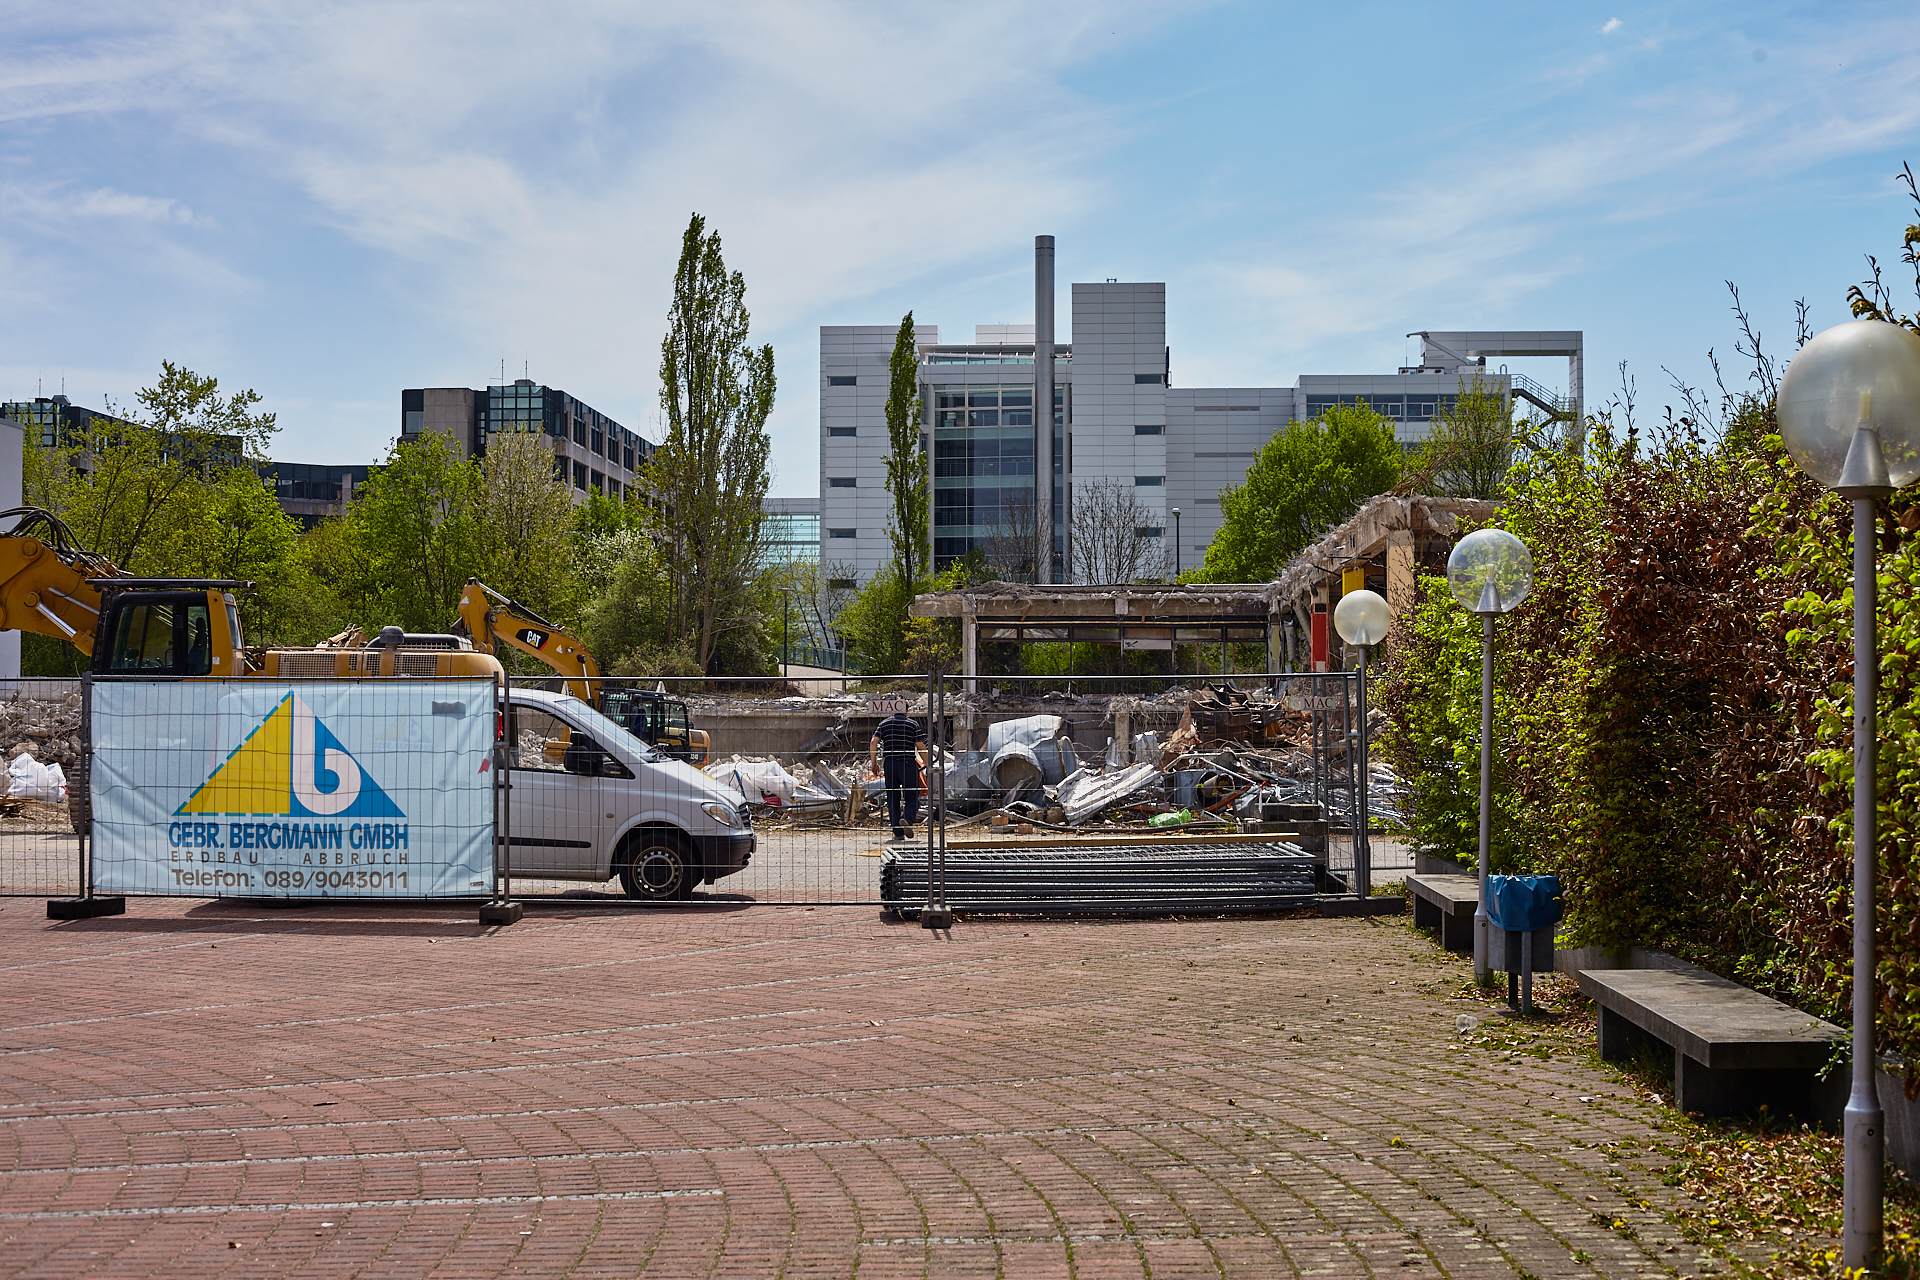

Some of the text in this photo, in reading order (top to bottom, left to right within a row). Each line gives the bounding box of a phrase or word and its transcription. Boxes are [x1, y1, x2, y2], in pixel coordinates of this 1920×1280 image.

[526, 630, 541, 648] CAT
[872, 700, 904, 712] MAC
[1303, 697, 1334, 709] MAC
[169, 821, 409, 850] GEBR. BERGMANN GMBH
[171, 850, 408, 866] ERDBAU ABBRUCH
[171, 868, 408, 890] Telefon: 089/9043011
